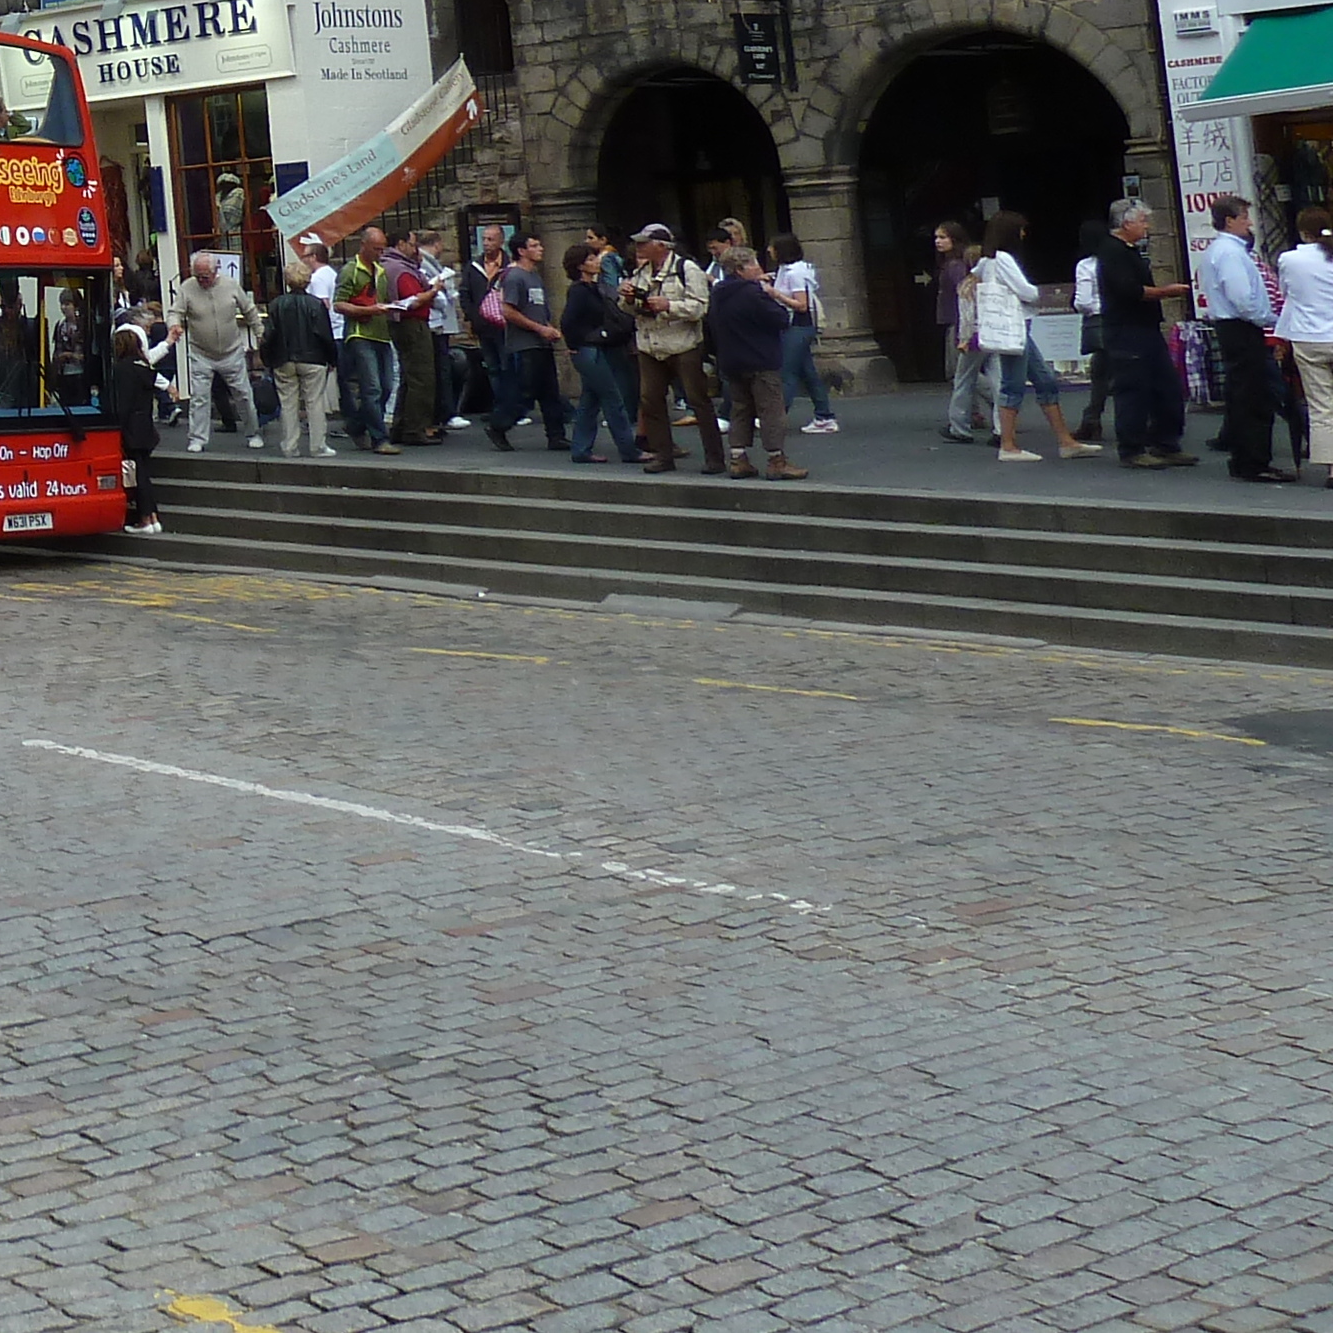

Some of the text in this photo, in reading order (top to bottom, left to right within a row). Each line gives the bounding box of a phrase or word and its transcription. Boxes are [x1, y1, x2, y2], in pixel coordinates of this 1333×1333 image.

[313, 1, 403, 35] Johnstons
[329, 35, 391, 53] Cashmere
[97, 54, 181, 83] HOUSE
[1167, 55, 1223, 68] CASHMERE
[321, 68, 408, 80] Made In Scotland
[278, 170, 348, 217] Gladstone's
[346, 149, 377, 174] Land
[0, 446, 13, 460] On
[33, 445, 51, 459] Hop
[53, 443, 68, 458] Off
[8, 481, 37, 498] valid
[45, 481, 59, 496] 24
[61, 482, 87, 495] hours
[29, 514, 47, 527] PSX
